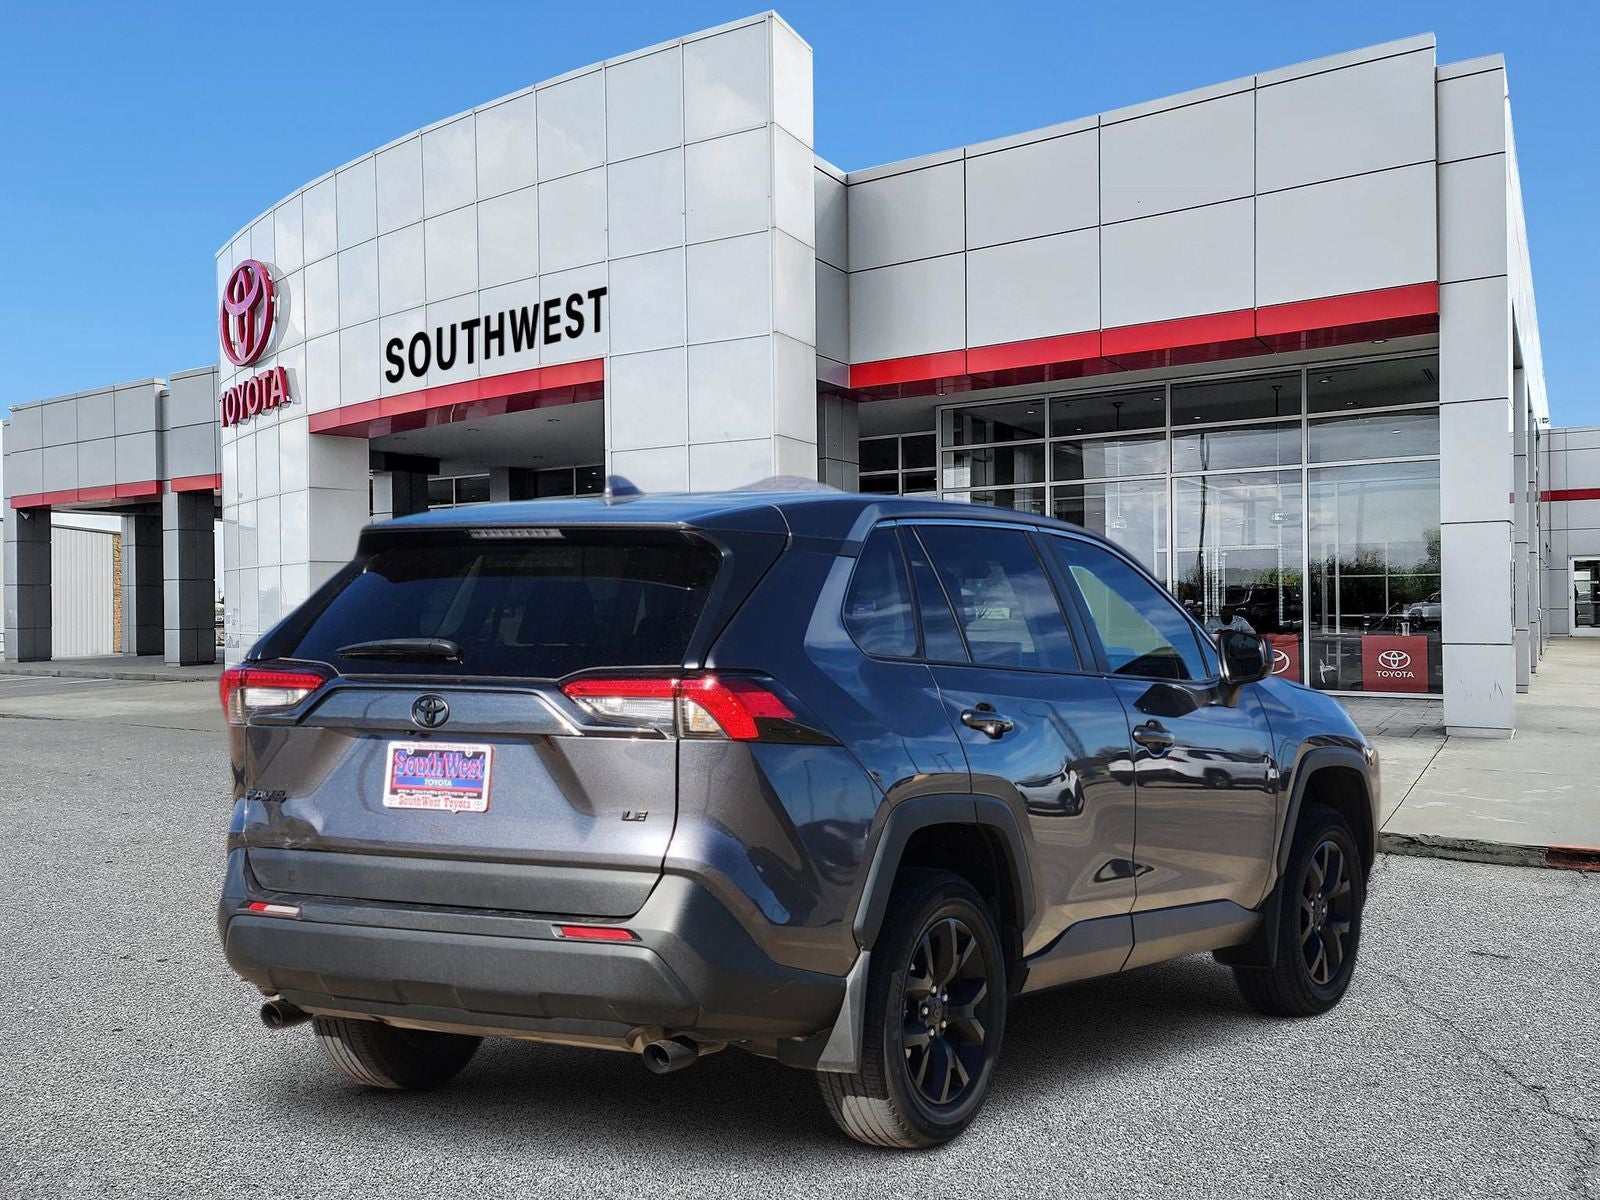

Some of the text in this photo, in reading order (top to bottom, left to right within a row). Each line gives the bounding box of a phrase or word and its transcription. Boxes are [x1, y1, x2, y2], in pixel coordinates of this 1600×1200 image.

[385, 286, 608, 384] SOUTHWEST
[218, 366, 289, 428] TOYOTA
[1375, 670, 1415, 678] TOYOTA
[394, 750, 485, 778] SouthWest
[424, 778, 453, 787] TOYOTA
[398, 795, 471, 810] SouthWest Toyota
[621, 810, 649, 822] LE
